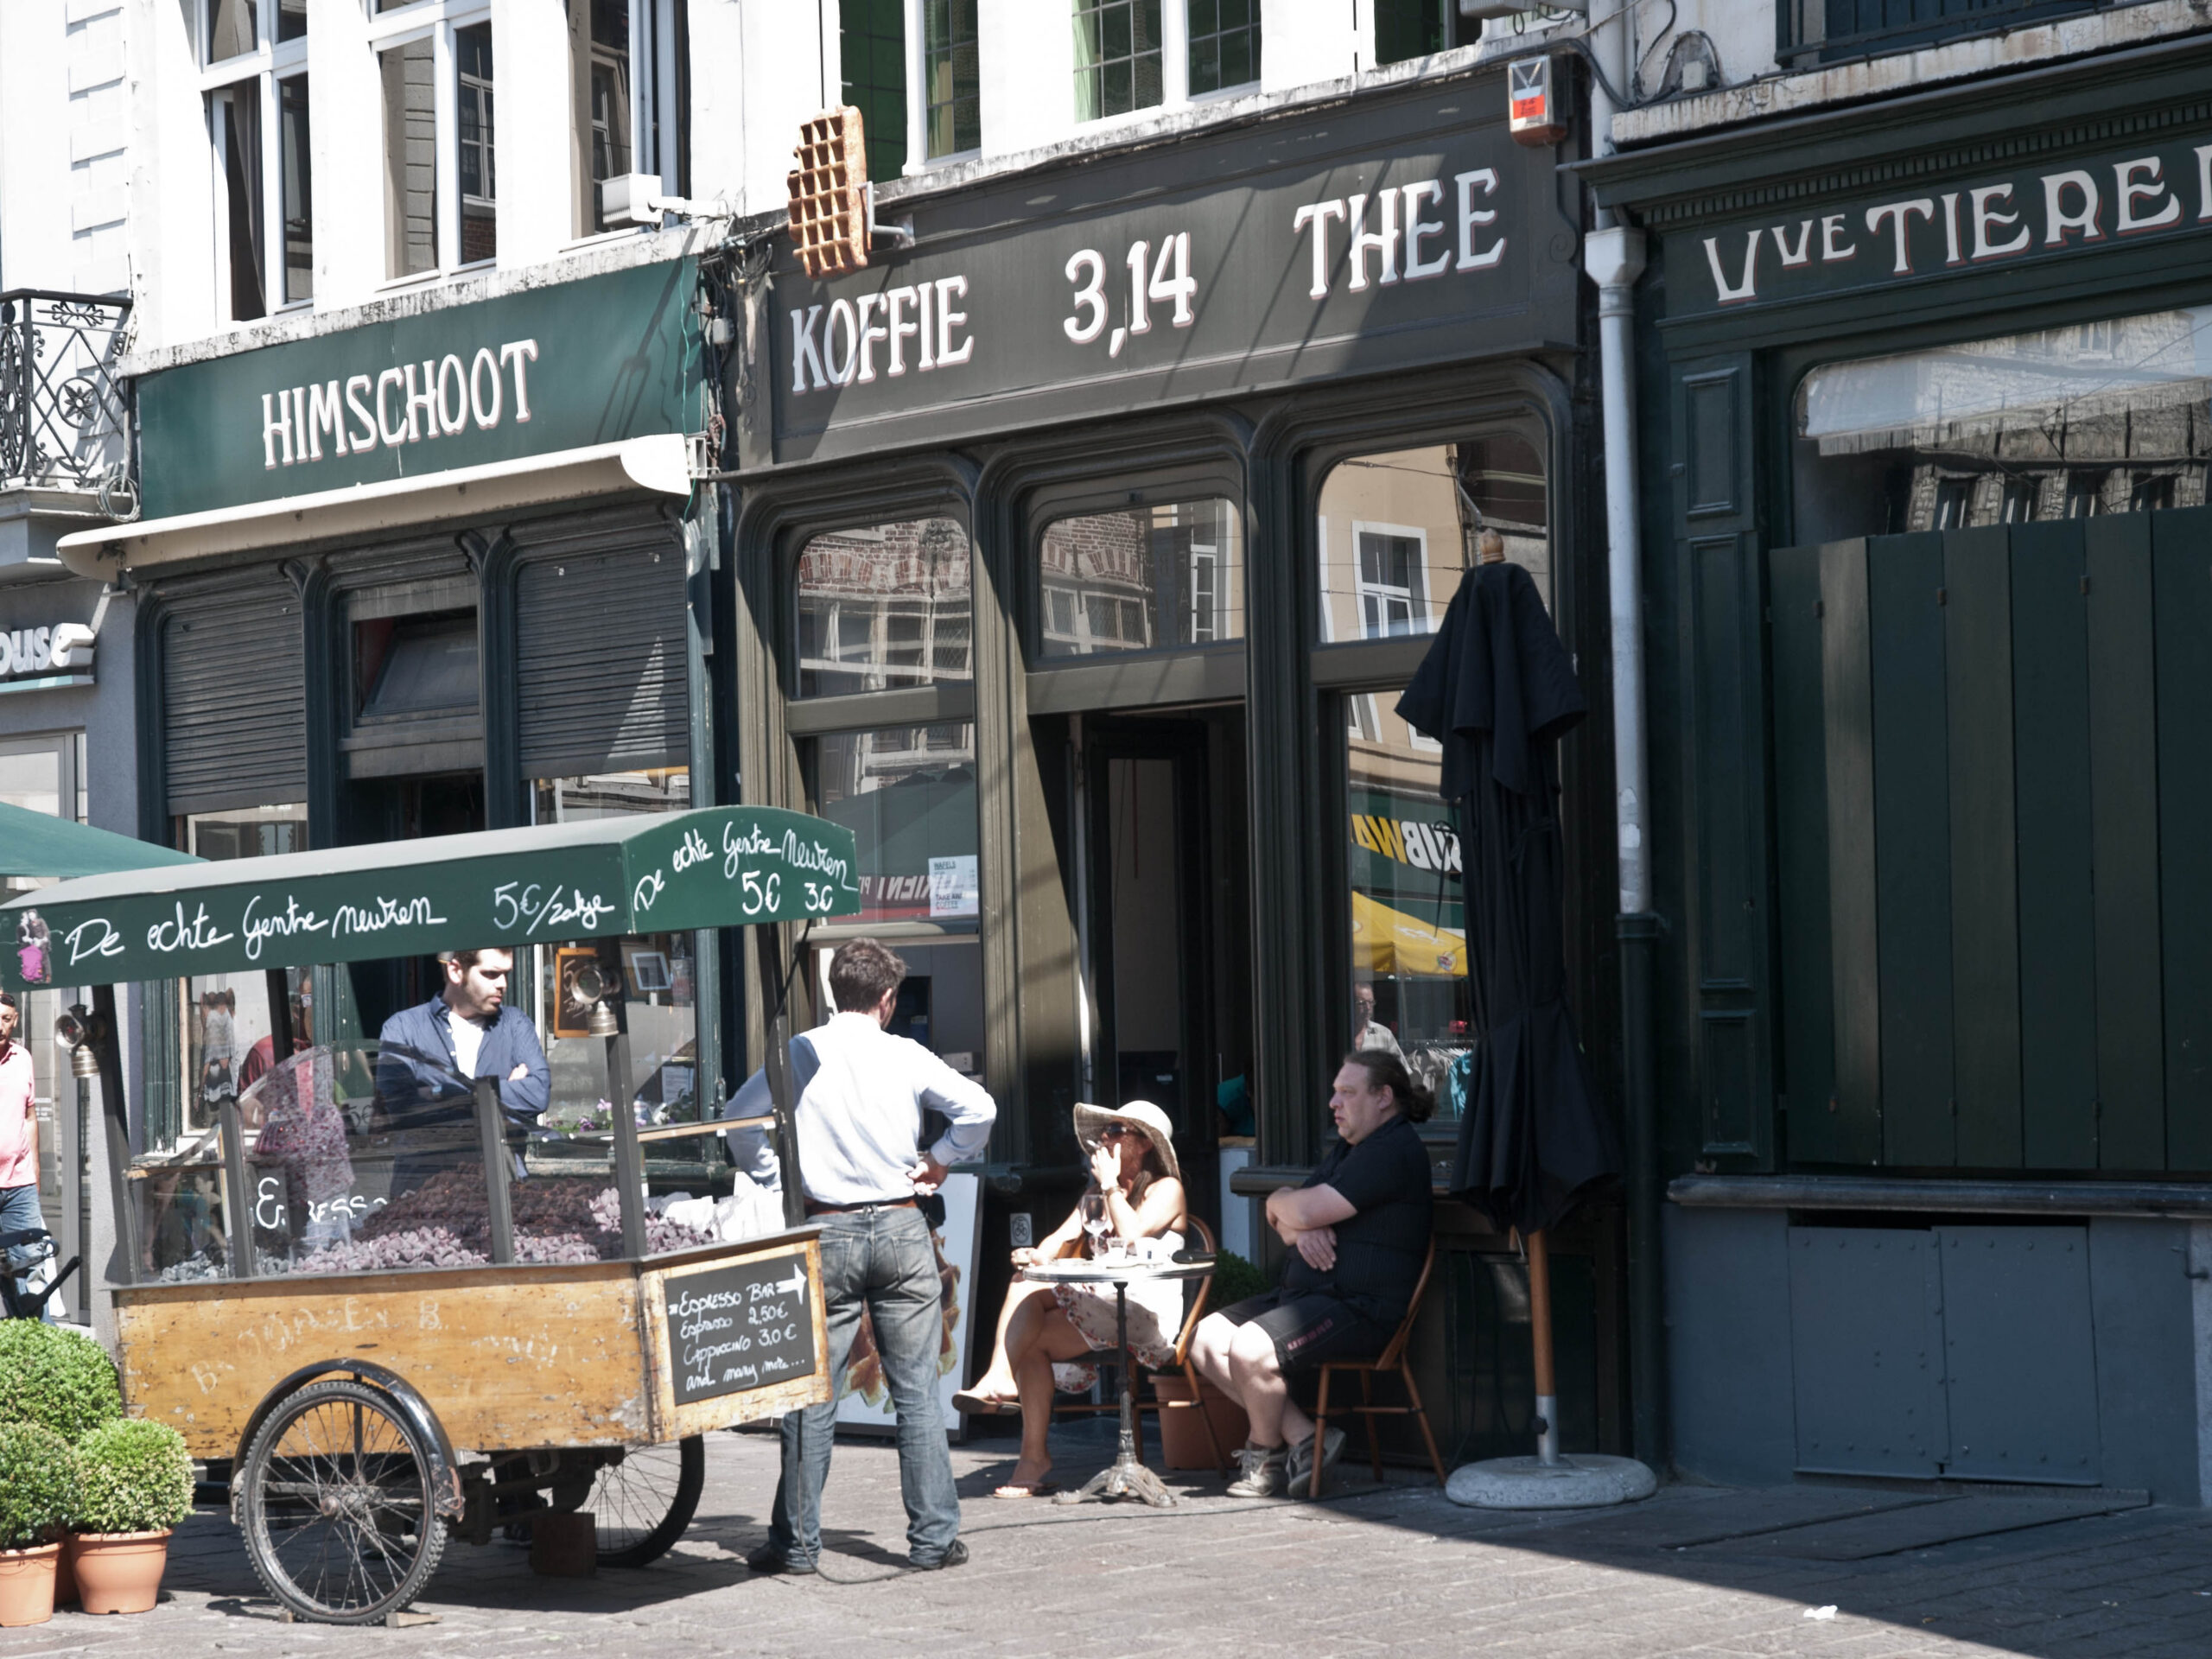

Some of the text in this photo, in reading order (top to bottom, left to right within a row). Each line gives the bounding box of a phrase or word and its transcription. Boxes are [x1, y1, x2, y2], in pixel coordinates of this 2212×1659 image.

[790, 167, 1507, 394] KOFFIE 3,14 THEE
[262, 339, 538, 469] HIMSCHOOT
[673, 829, 714, 872] echte
[741, 870, 833, 915] 5€ 3€
[64, 918, 124, 965] De
[147, 901, 233, 951] echte
